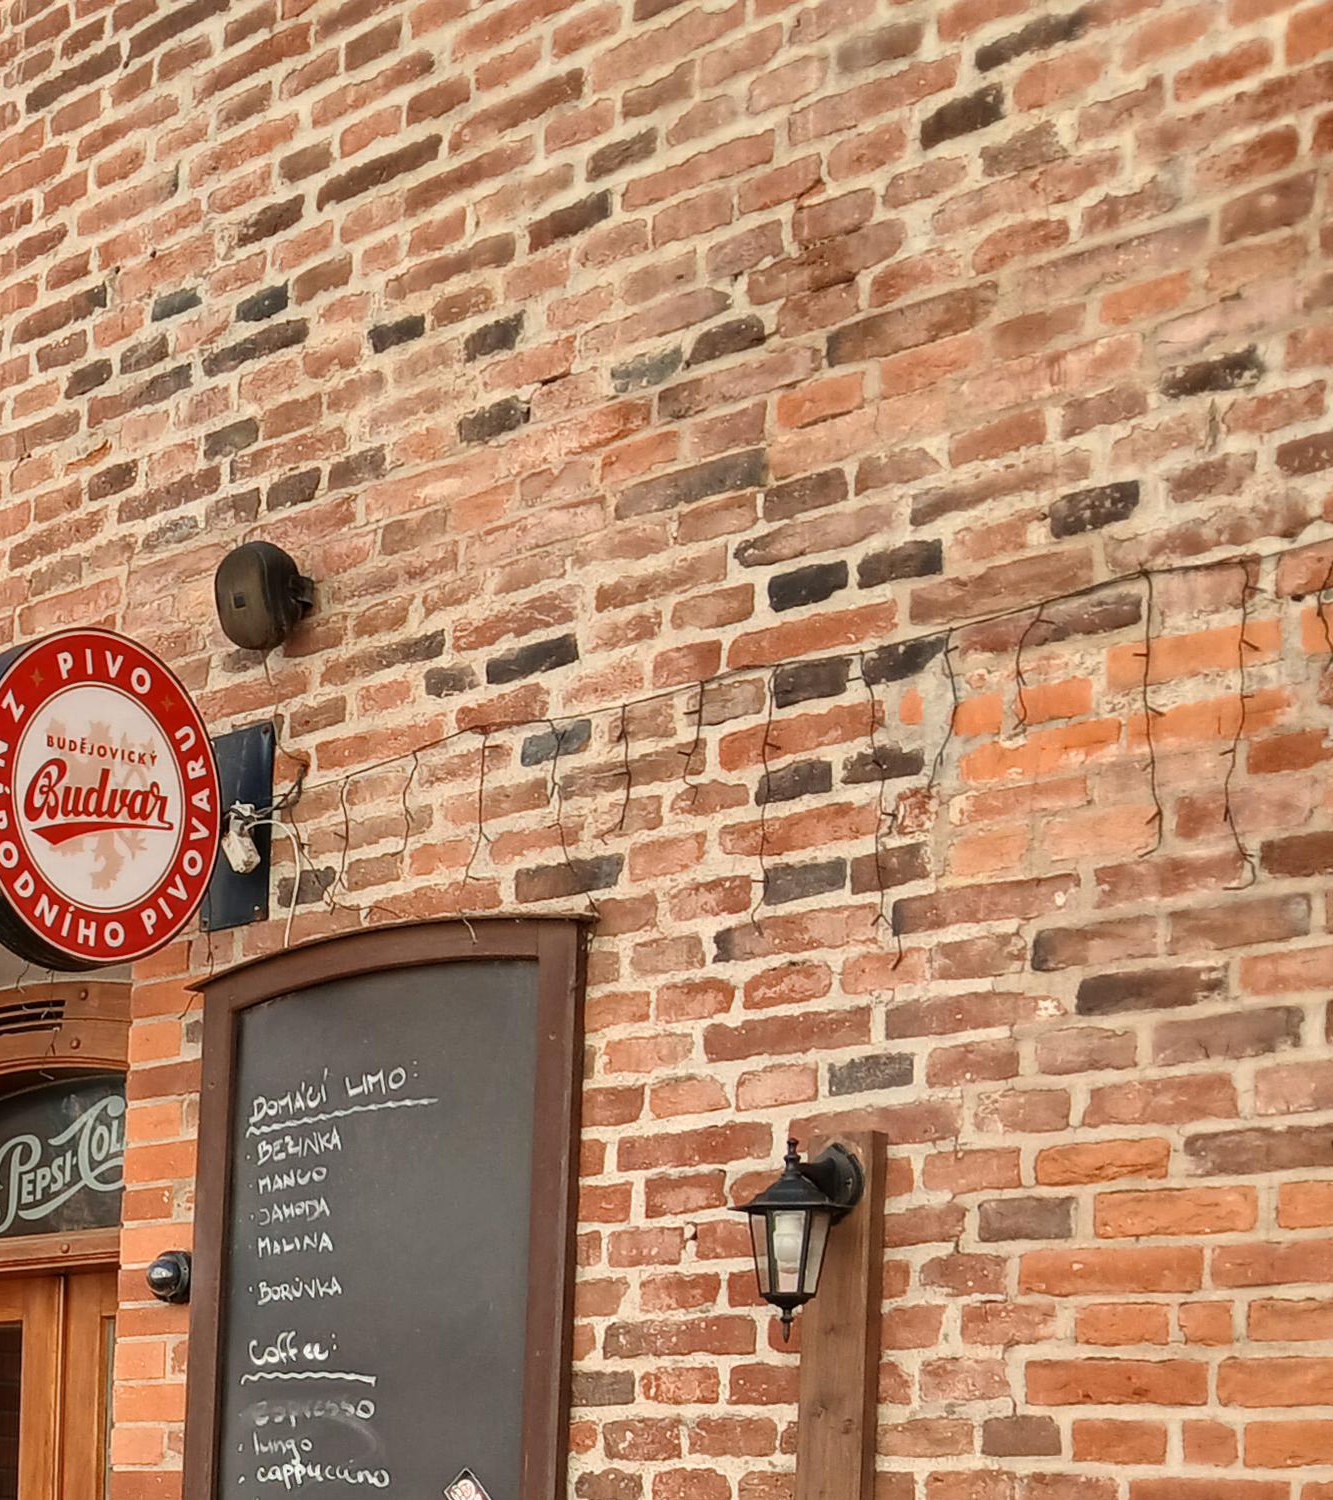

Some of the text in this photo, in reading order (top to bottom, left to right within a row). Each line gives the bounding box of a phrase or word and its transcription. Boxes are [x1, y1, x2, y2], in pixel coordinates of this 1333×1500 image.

[56, 648, 152, 695] PIVO
[46, 734, 158, 767] BUDĚJOVICKÝ
[0, 688, 26, 723] Z
[140, 725, 212, 936] PIVOVARU
[23, 757, 175, 833] Budvar
[248, 1067, 329, 1124] DOMÁCÍ
[258, 1196, 331, 1226] JAHODA
[257, 1231, 334, 1258] MALINA
[256, 1276, 343, 1306] BORŮVKA
[253, 1431, 313, 1466] lungo
[256, 1458, 391, 1490] cappuccino
